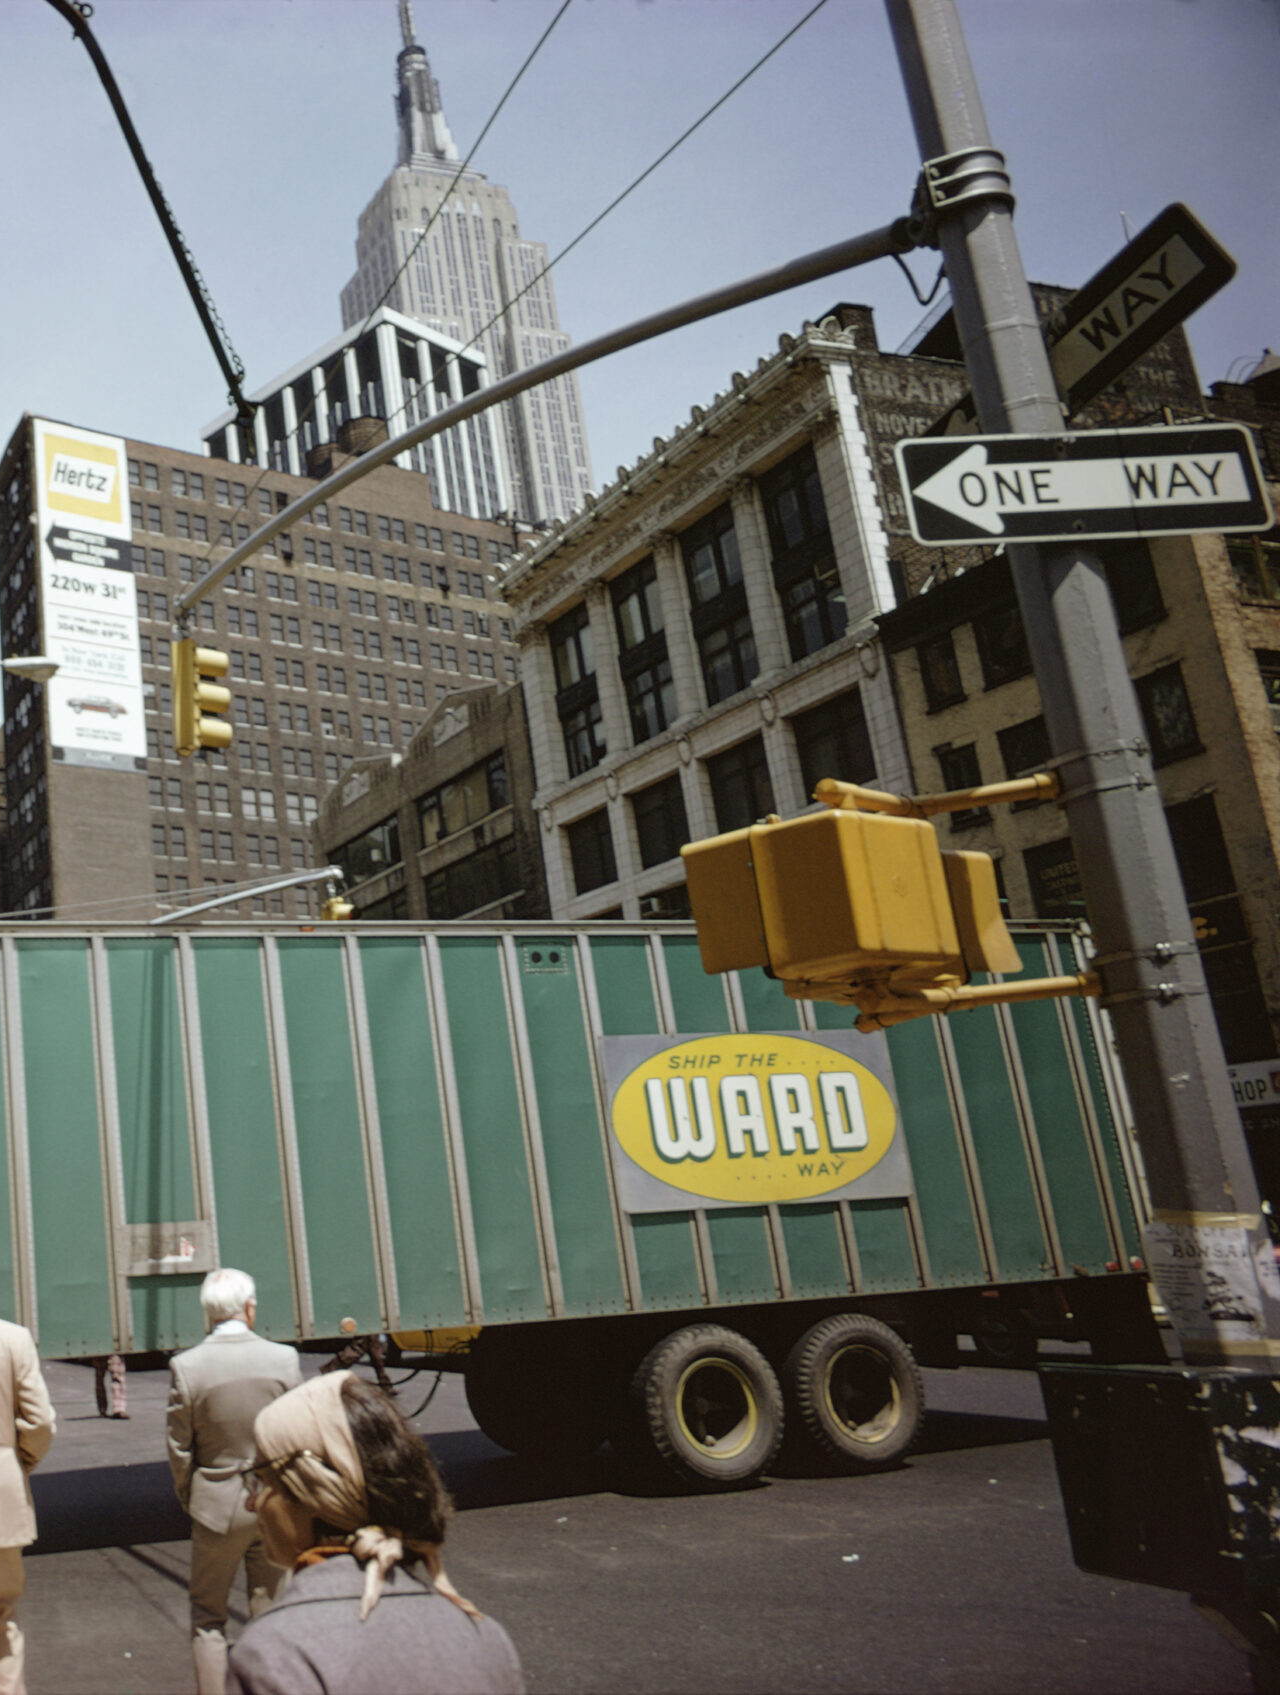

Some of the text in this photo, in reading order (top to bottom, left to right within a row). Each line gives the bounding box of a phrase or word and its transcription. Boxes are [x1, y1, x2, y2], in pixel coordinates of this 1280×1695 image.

[1079, 251, 1178, 353] WAY
[875, 412, 934, 436] NOVE
[53, 460, 108, 493] Hertz
[958, 459, 1224, 508] ONE WAY
[668, 1053, 779, 1070] SHIP THE
[645, 1071, 869, 1164] WARD
[798, 1161, 845, 1177] WAY
